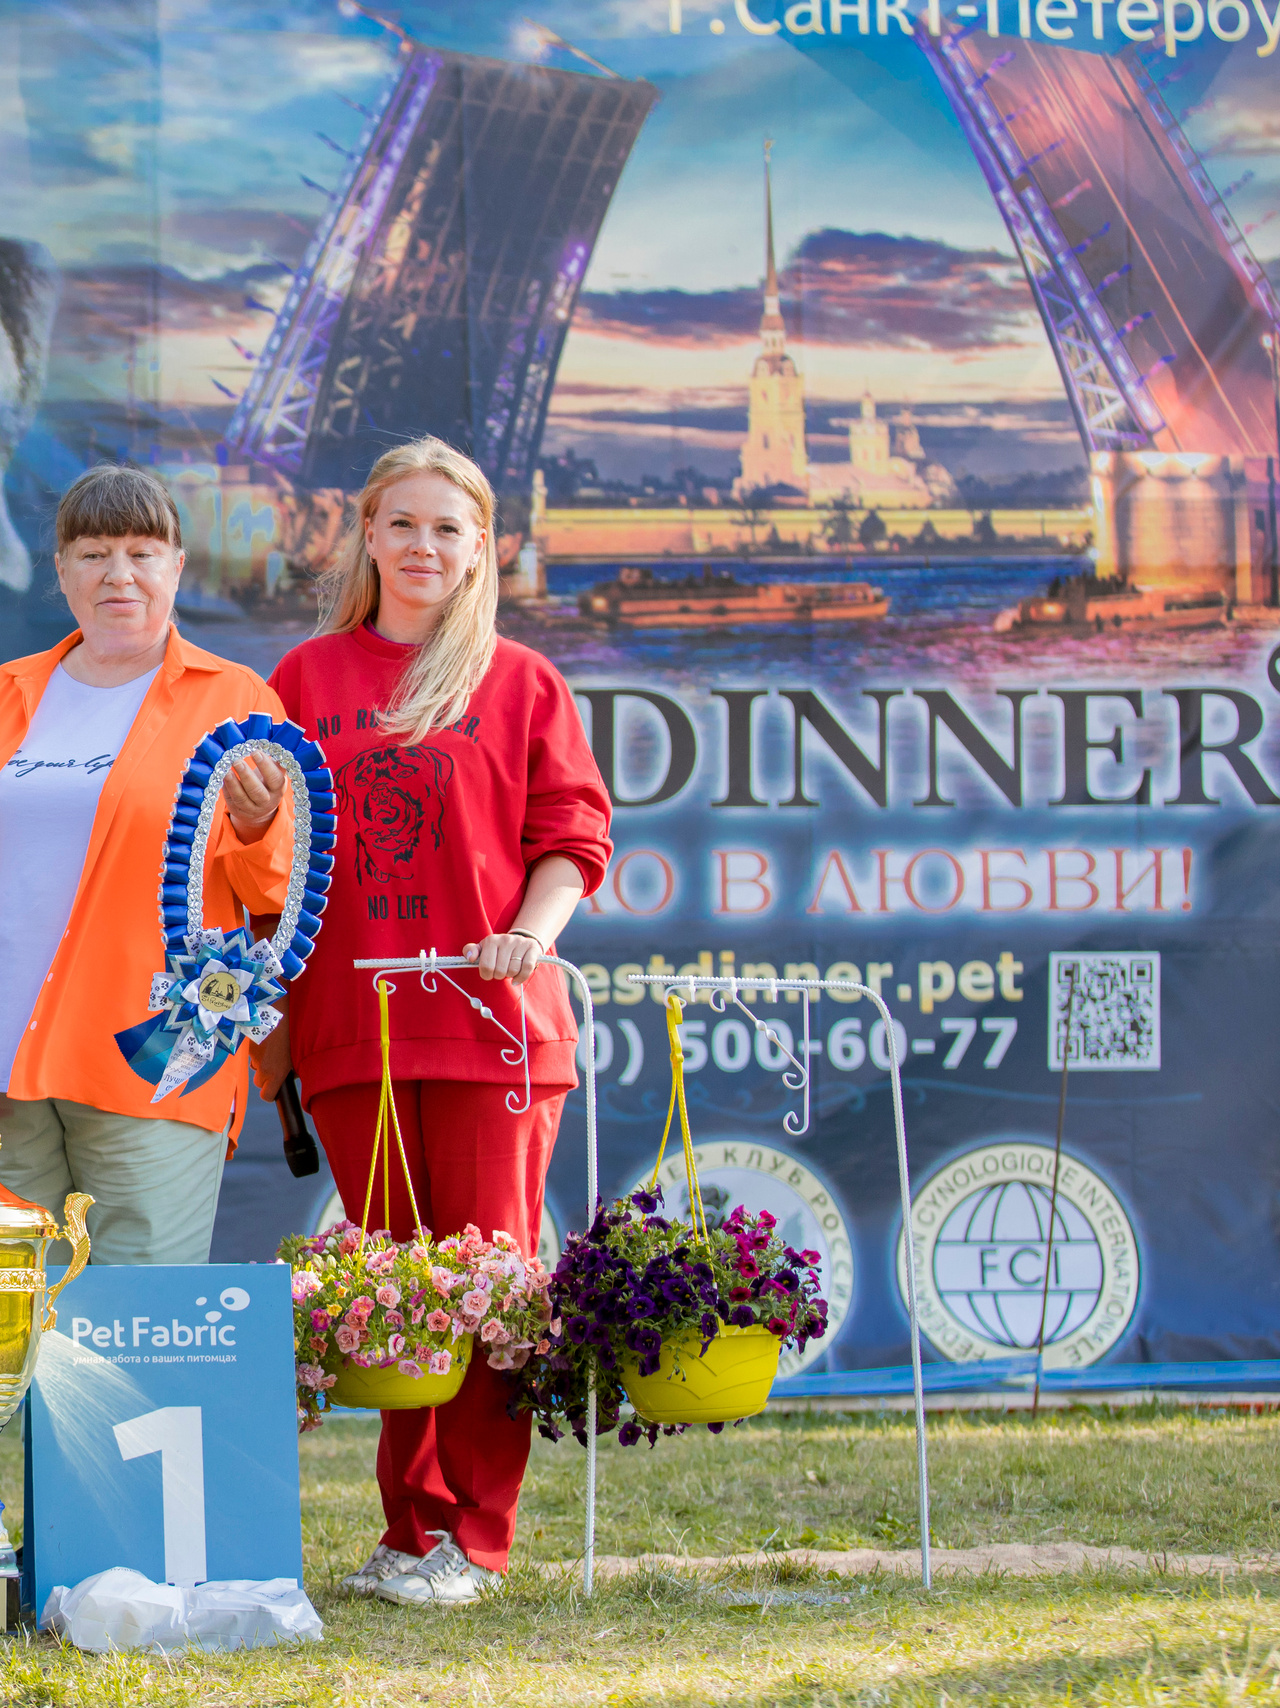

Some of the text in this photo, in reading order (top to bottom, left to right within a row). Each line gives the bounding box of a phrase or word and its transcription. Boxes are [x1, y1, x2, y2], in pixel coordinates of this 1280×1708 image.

[316, 714, 341, 741] NO
[573, 687, 1280, 807] DINNER
[712, 849, 773, 915] В
[805, 847, 1195, 915] ЛЮБВИ!
[367, 894, 429, 920] NO LIFE
[563, 950, 1024, 1014] estdinner.pet
[681, 1017, 1019, 1074] 500-60-77
[723, 1146, 807, 1187] КЛУБ
[916, 1151, 1080, 1228] CYNOLOGIQUE
[1063, 1178, 1131, 1365] INTERNATIONALE
[979, 1247, 1062, 1288] FCI
[71, 1315, 238, 1348] Pet Fabric
[72, 1353, 237, 1366] умная забота о ваших питомцах
[111, 1405, 208, 1585] 1
